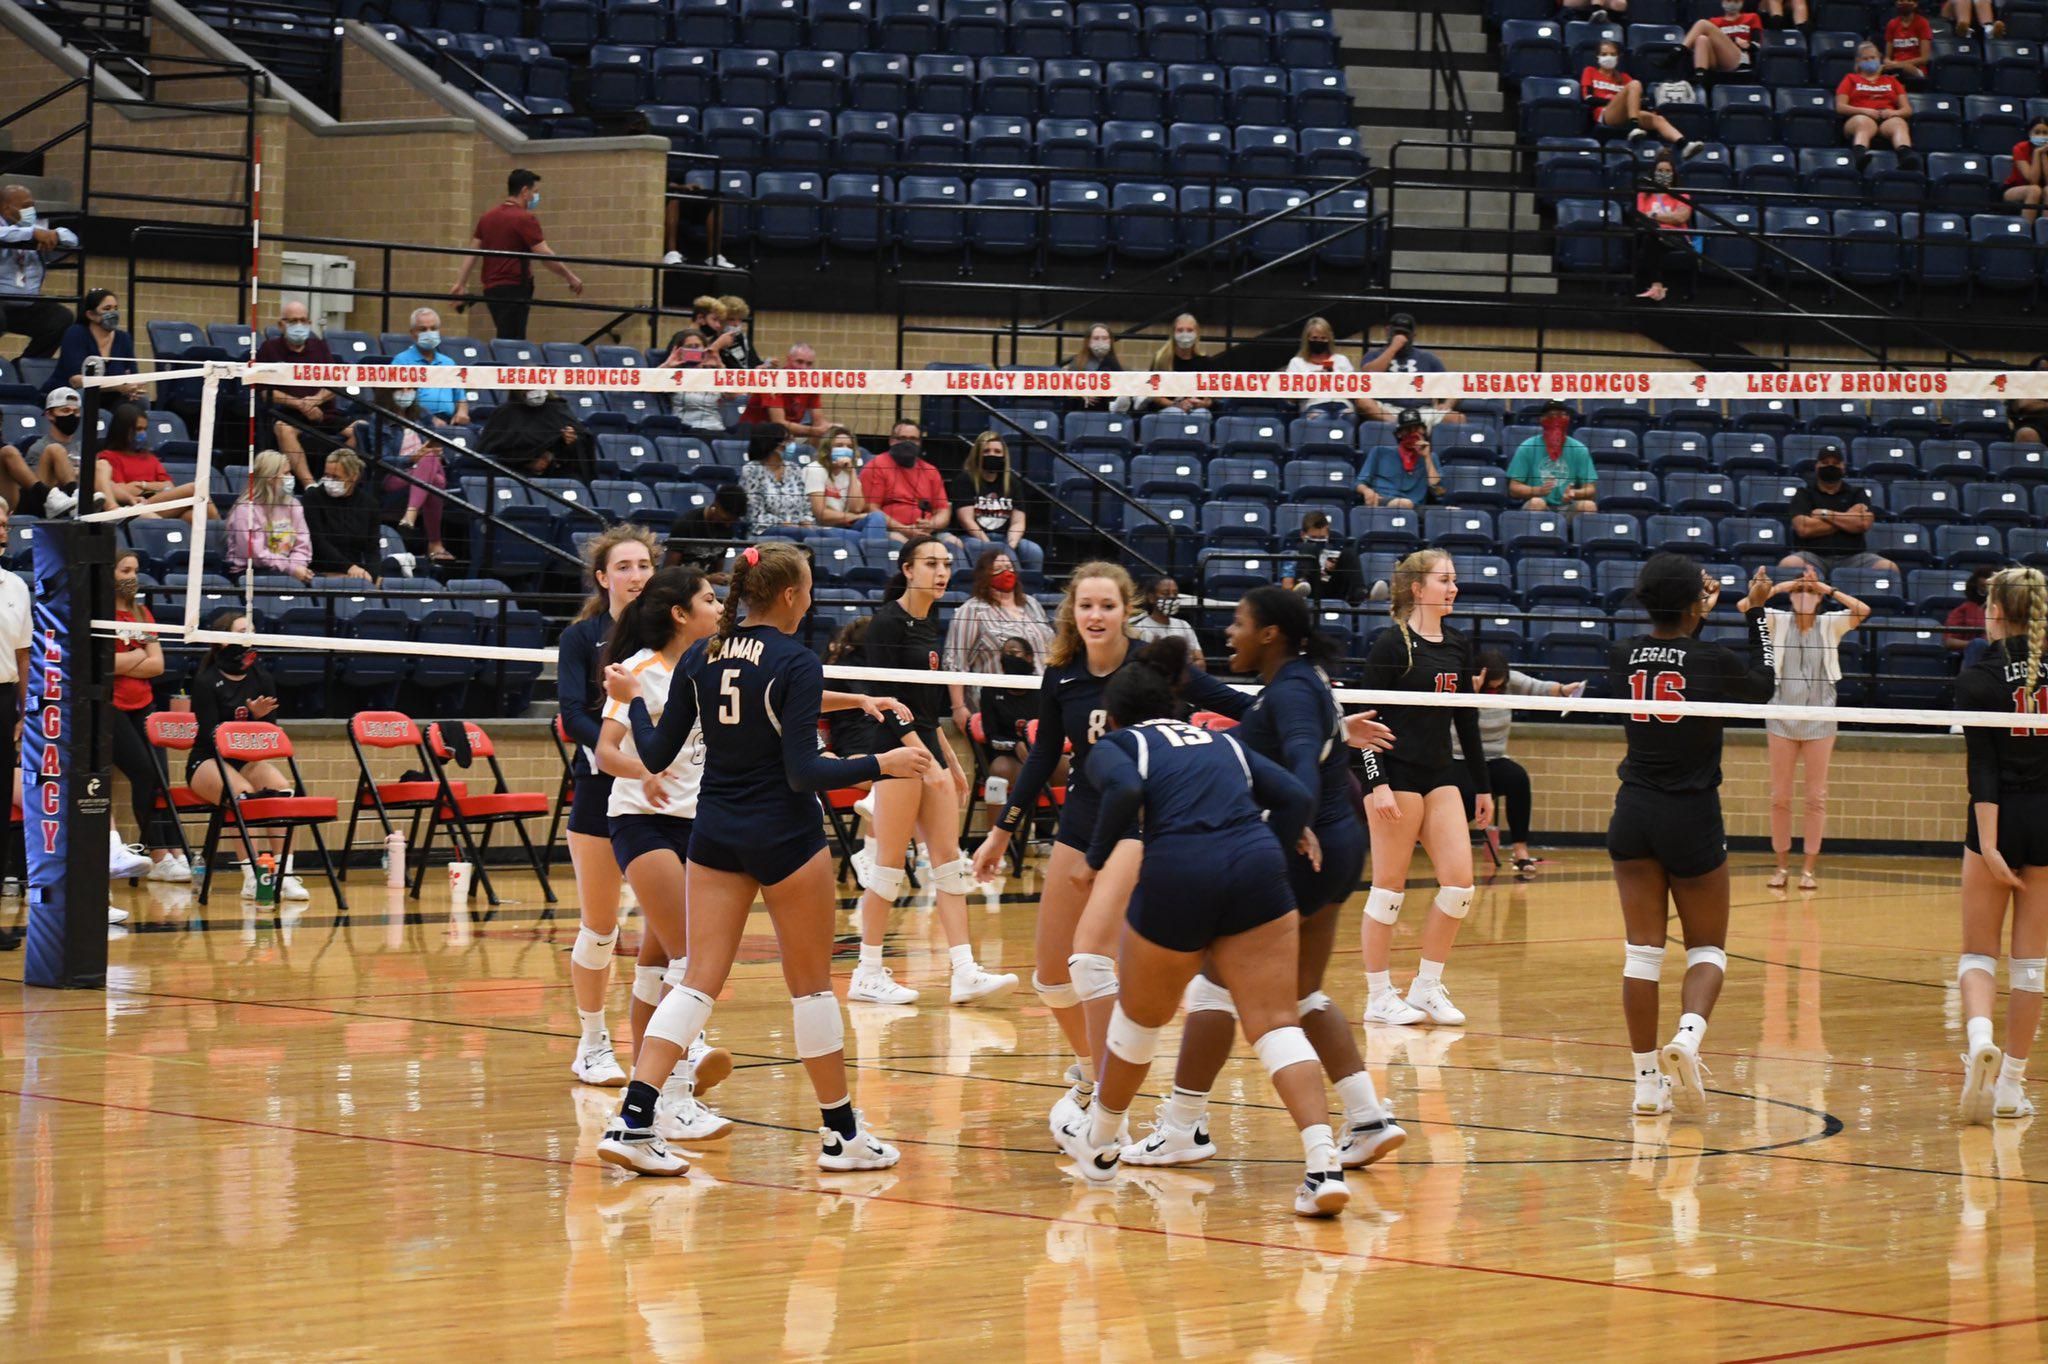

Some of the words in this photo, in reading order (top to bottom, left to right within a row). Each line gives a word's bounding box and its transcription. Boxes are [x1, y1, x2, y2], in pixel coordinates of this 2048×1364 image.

[294, 365, 350, 381] LEGACY
[356, 366, 427, 383] BRONCOS
[497, 368, 557, 385] LEGACY
[564, 369, 640, 386] BRONCOS
[714, 370, 778, 387] LEGACY
[787, 371, 866, 388] BRONCOS
[947, 372, 1015, 389] LEGACY
[1024, 373, 1111, 390] BRONCOS
[1197, 373, 1270, 391] LEGACY
[1279, 374, 1371, 392] BRONCOS
[1463, 374, 1541, 392] LEGACY
[1551, 374, 1650, 392] BRONCOS
[1747, 373, 1831, 392] LEGACY
[1841, 373, 1947, 392] BRONCOS
[1629, 647, 1687, 666] LEGACY
[1434, 673, 1458, 694] 15
[718, 669, 741, 725] 5
[1628, 669, 1686, 723] 16
[362, 720, 408, 738] LEGACY
[1087, 709, 1107, 744] 8
[1155, 714, 1213, 747] 13
[41, 629, 62, 854] LEGACY
[225, 732, 279, 750] LEGACY
[260, 872, 272, 886] G
